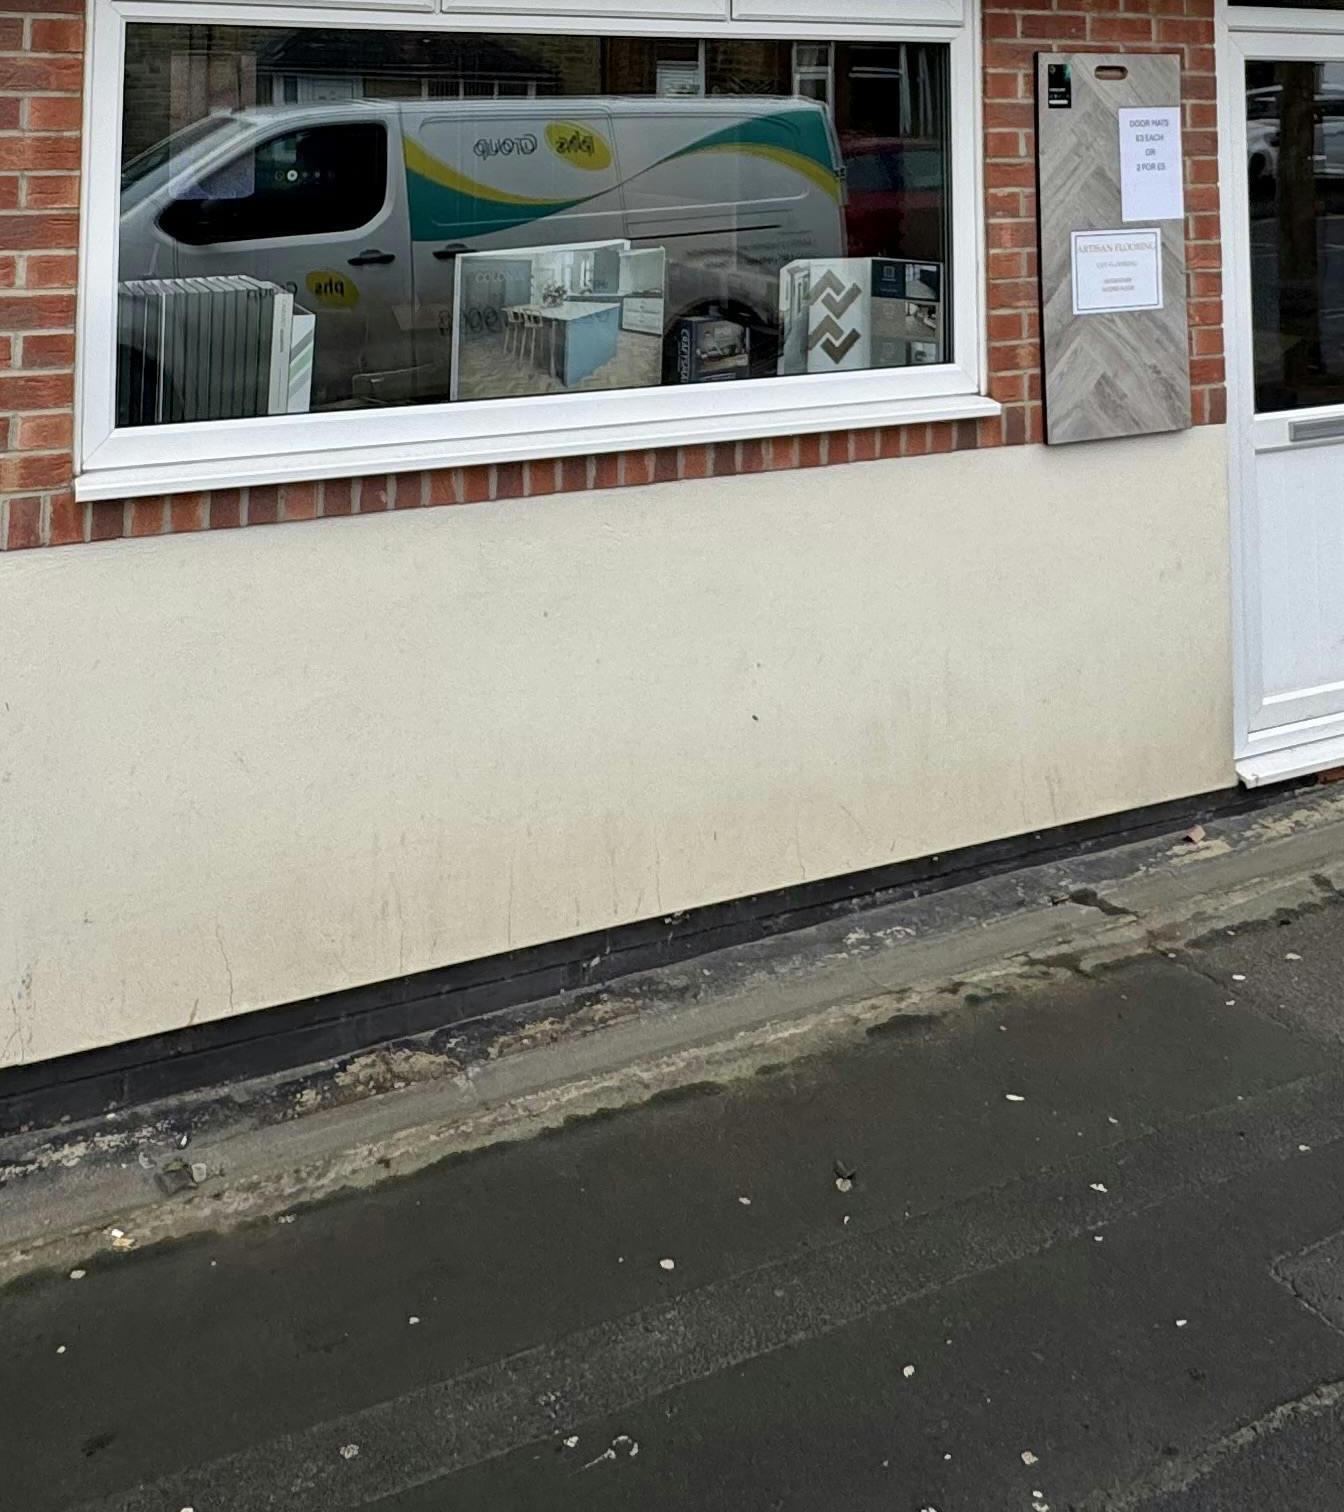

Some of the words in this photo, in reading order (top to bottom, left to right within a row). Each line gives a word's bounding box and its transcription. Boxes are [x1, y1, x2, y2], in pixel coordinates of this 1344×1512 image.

[1129, 119, 1150, 127] DOOR
[1151, 118, 1169, 127] MATS
[1145, 134, 1164, 142] EACH
[1145, 148, 1156, 156] OR
[1142, 163, 1156, 171] FOR
